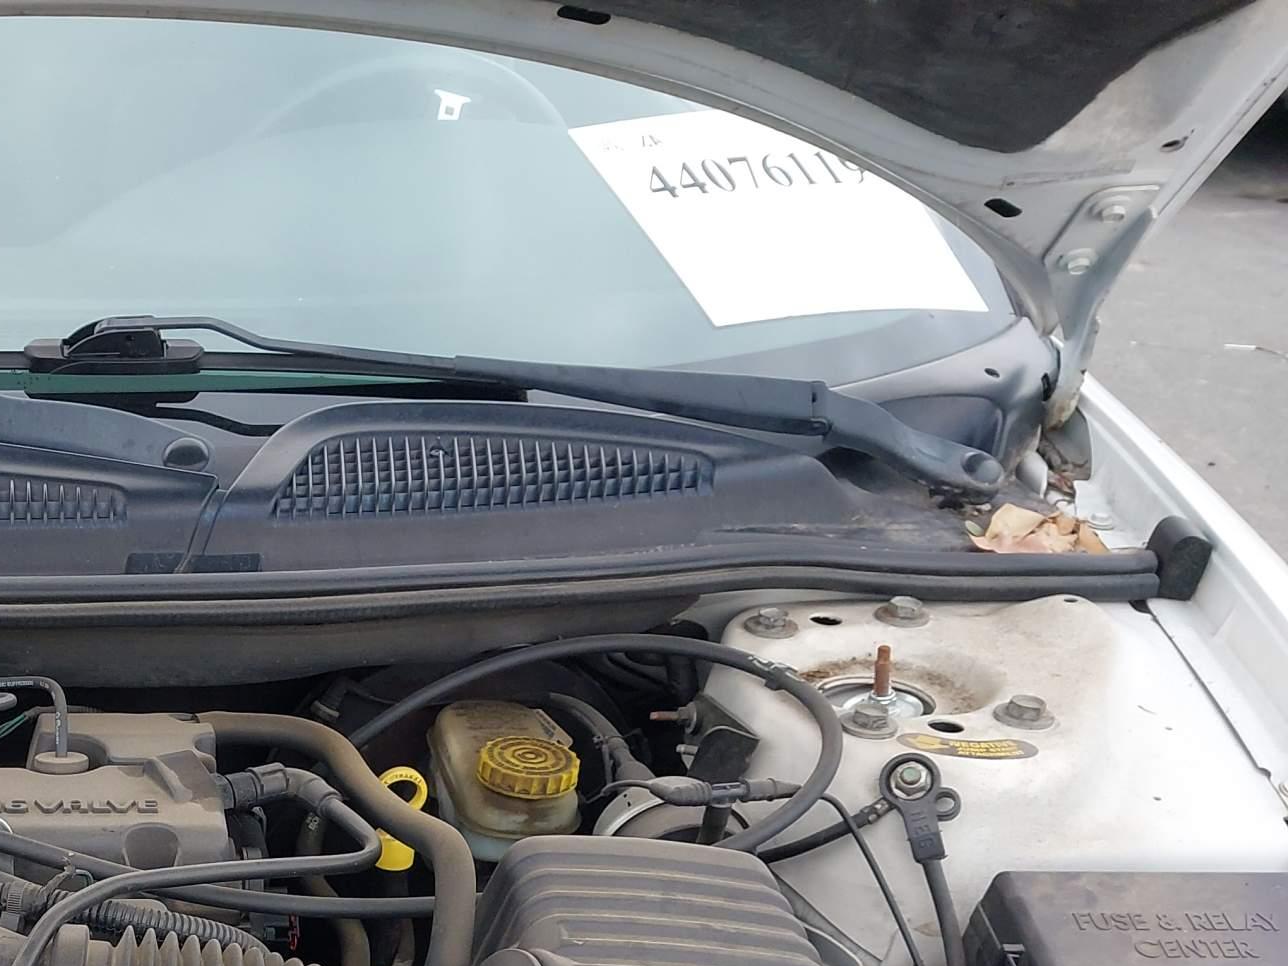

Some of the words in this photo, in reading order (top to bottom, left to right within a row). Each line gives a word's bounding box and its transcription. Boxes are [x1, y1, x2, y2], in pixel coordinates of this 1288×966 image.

[1072, 912, 1150, 931] FUSE
[1156, 912, 1182, 931] &
[1185, 912, 1280, 932] RELAY
[1134, 939, 1262, 959] CENTER
